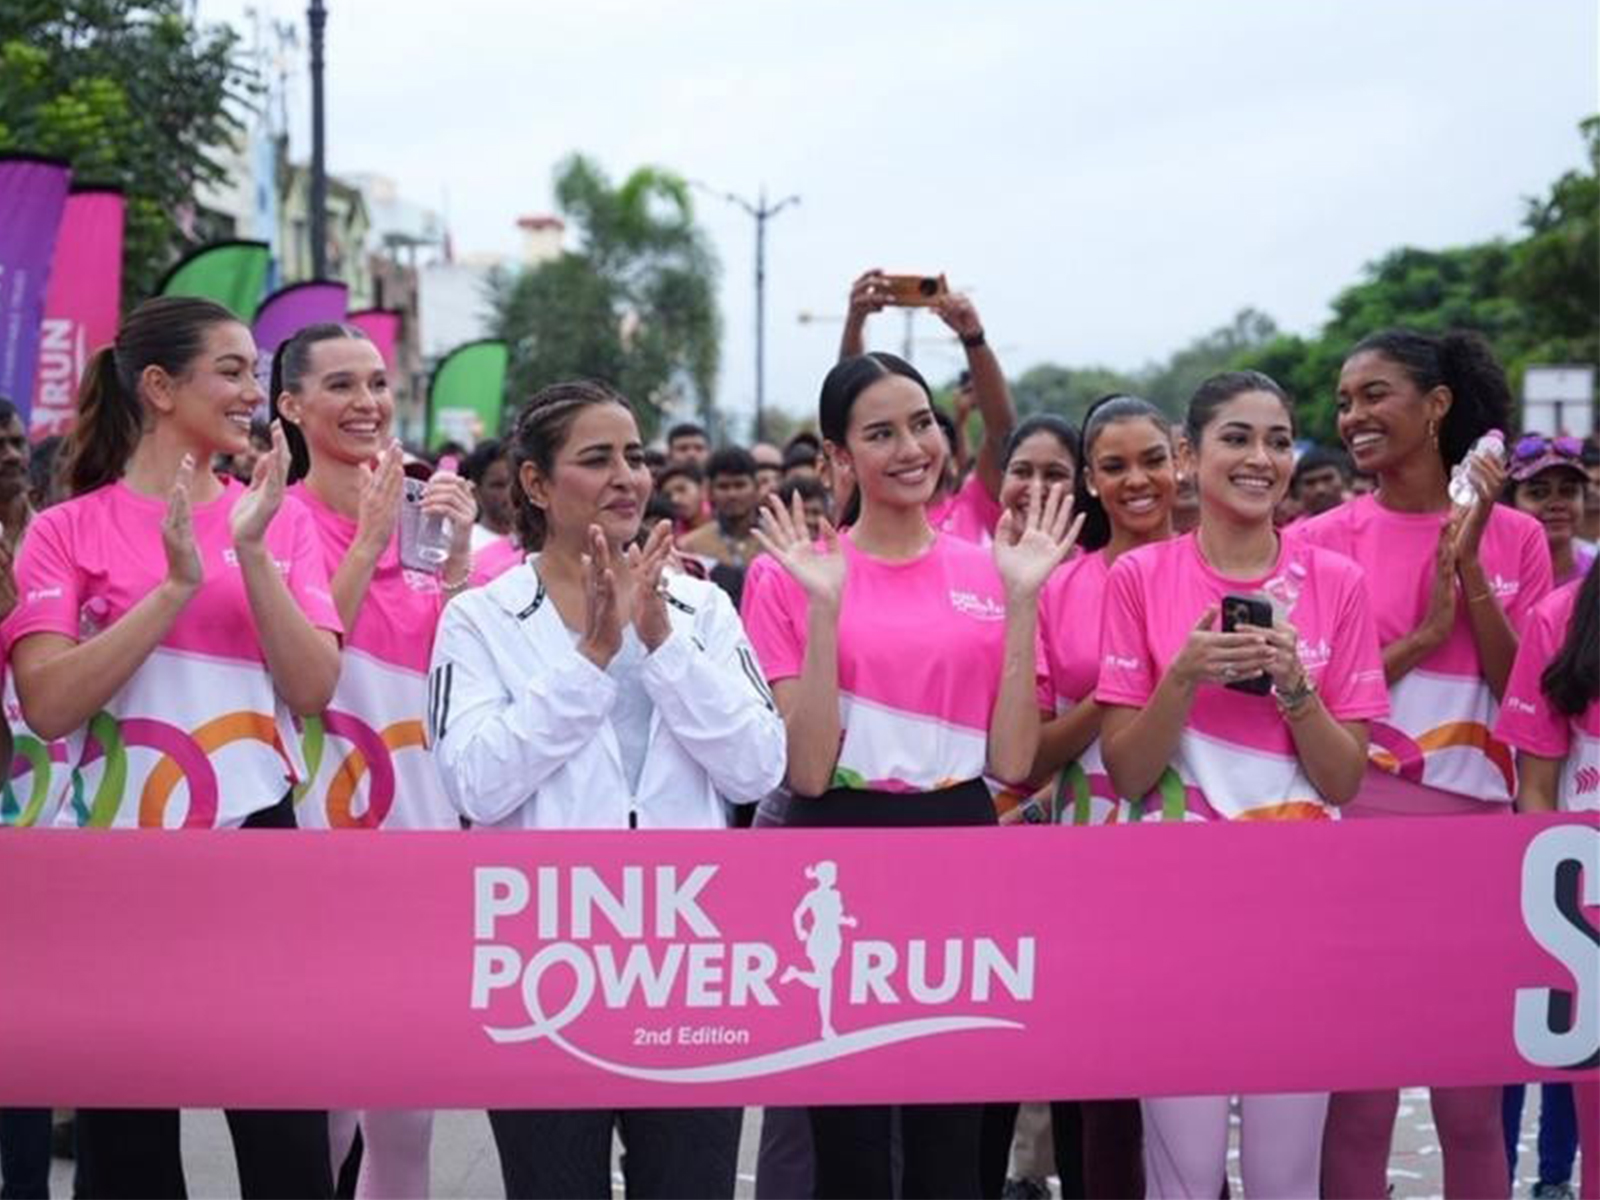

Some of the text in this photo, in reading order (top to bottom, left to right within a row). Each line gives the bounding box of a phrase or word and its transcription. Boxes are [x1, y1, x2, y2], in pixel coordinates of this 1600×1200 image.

[39, 319, 72, 405] RUN
[473, 865, 721, 940] PINK
[470, 937, 1036, 1012] POWER RUN
[633, 1025, 750, 1046] 2nd Edition
